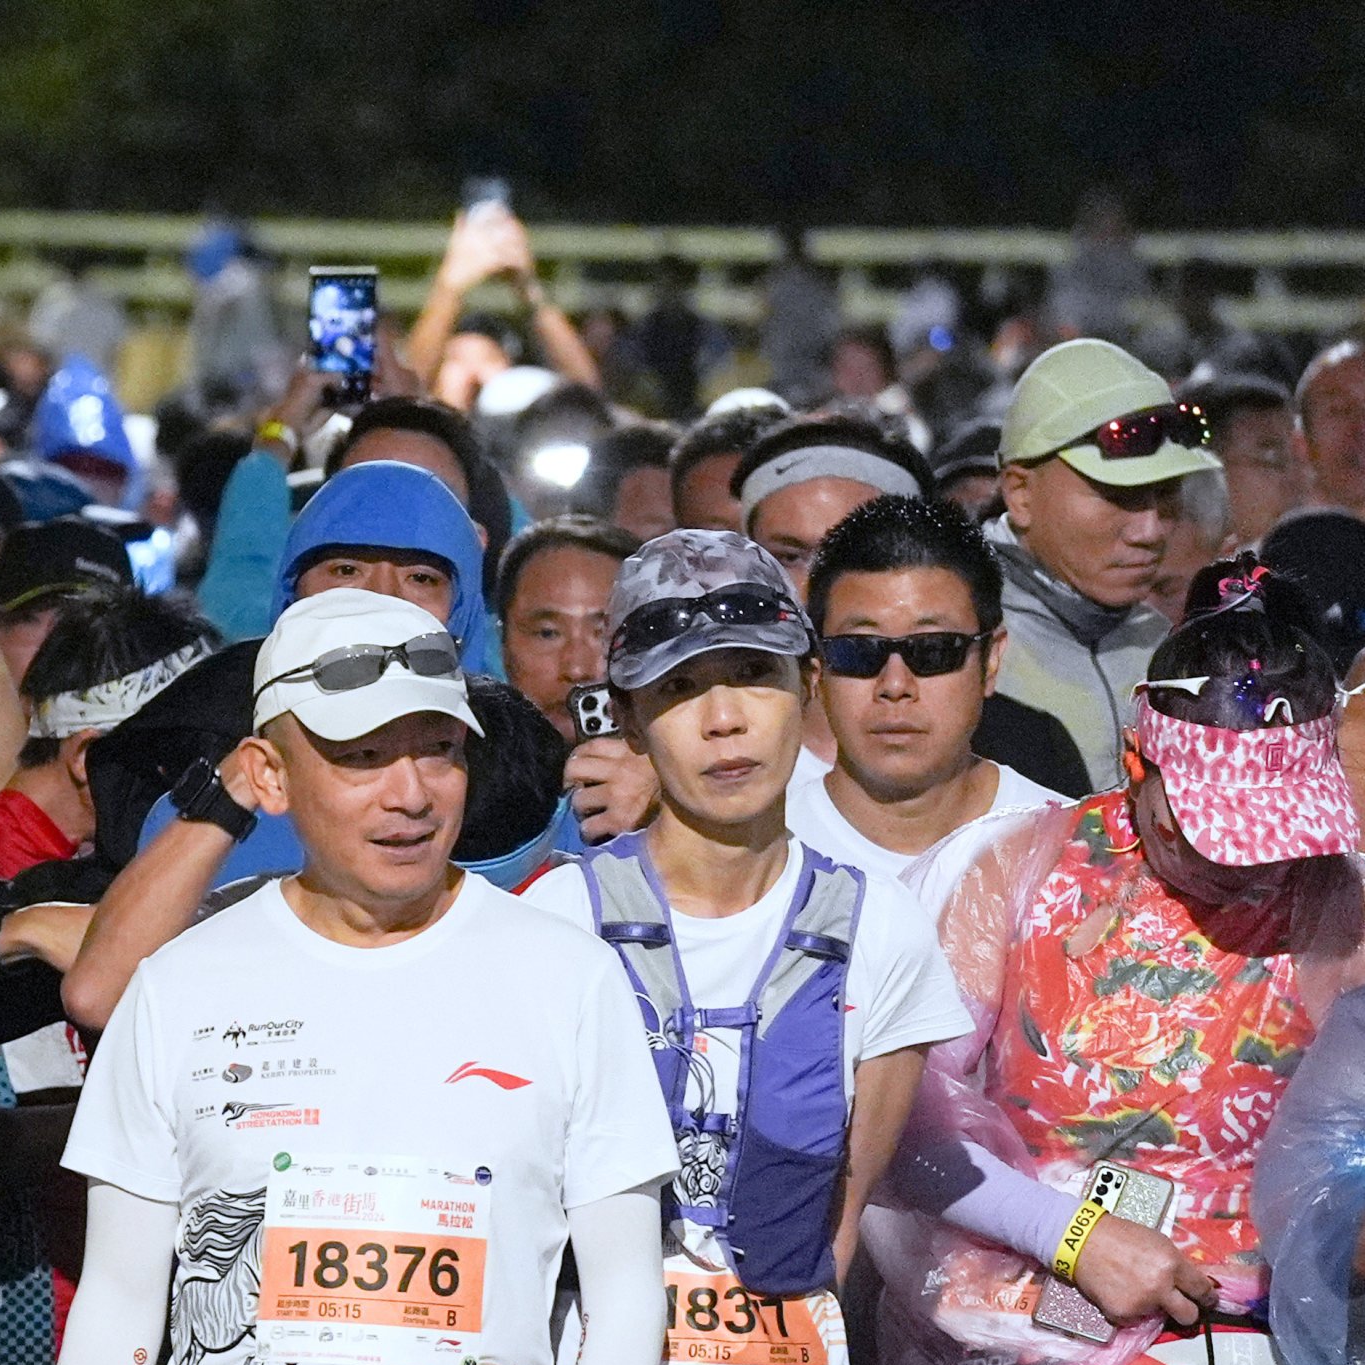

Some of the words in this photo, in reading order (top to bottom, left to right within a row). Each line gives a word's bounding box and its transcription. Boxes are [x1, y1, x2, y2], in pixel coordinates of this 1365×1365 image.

[248, 1019, 305, 1032] RunOurCity
[250, 1109, 302, 1119] HONGKONG
[236, 1117, 302, 1130] STREETATHON
[421, 1198, 476, 1214] MARATHON
[437, 1215, 473, 1229] 馬拉松
[1065, 1207, 1097, 1252] A063
[288, 1240, 460, 1298] 18376
[318, 1302, 362, 1319] 05:15
[447, 1310, 457, 1327] B
[688, 1343, 731, 1361] 05:15
[801, 1347, 810, 1363] B
